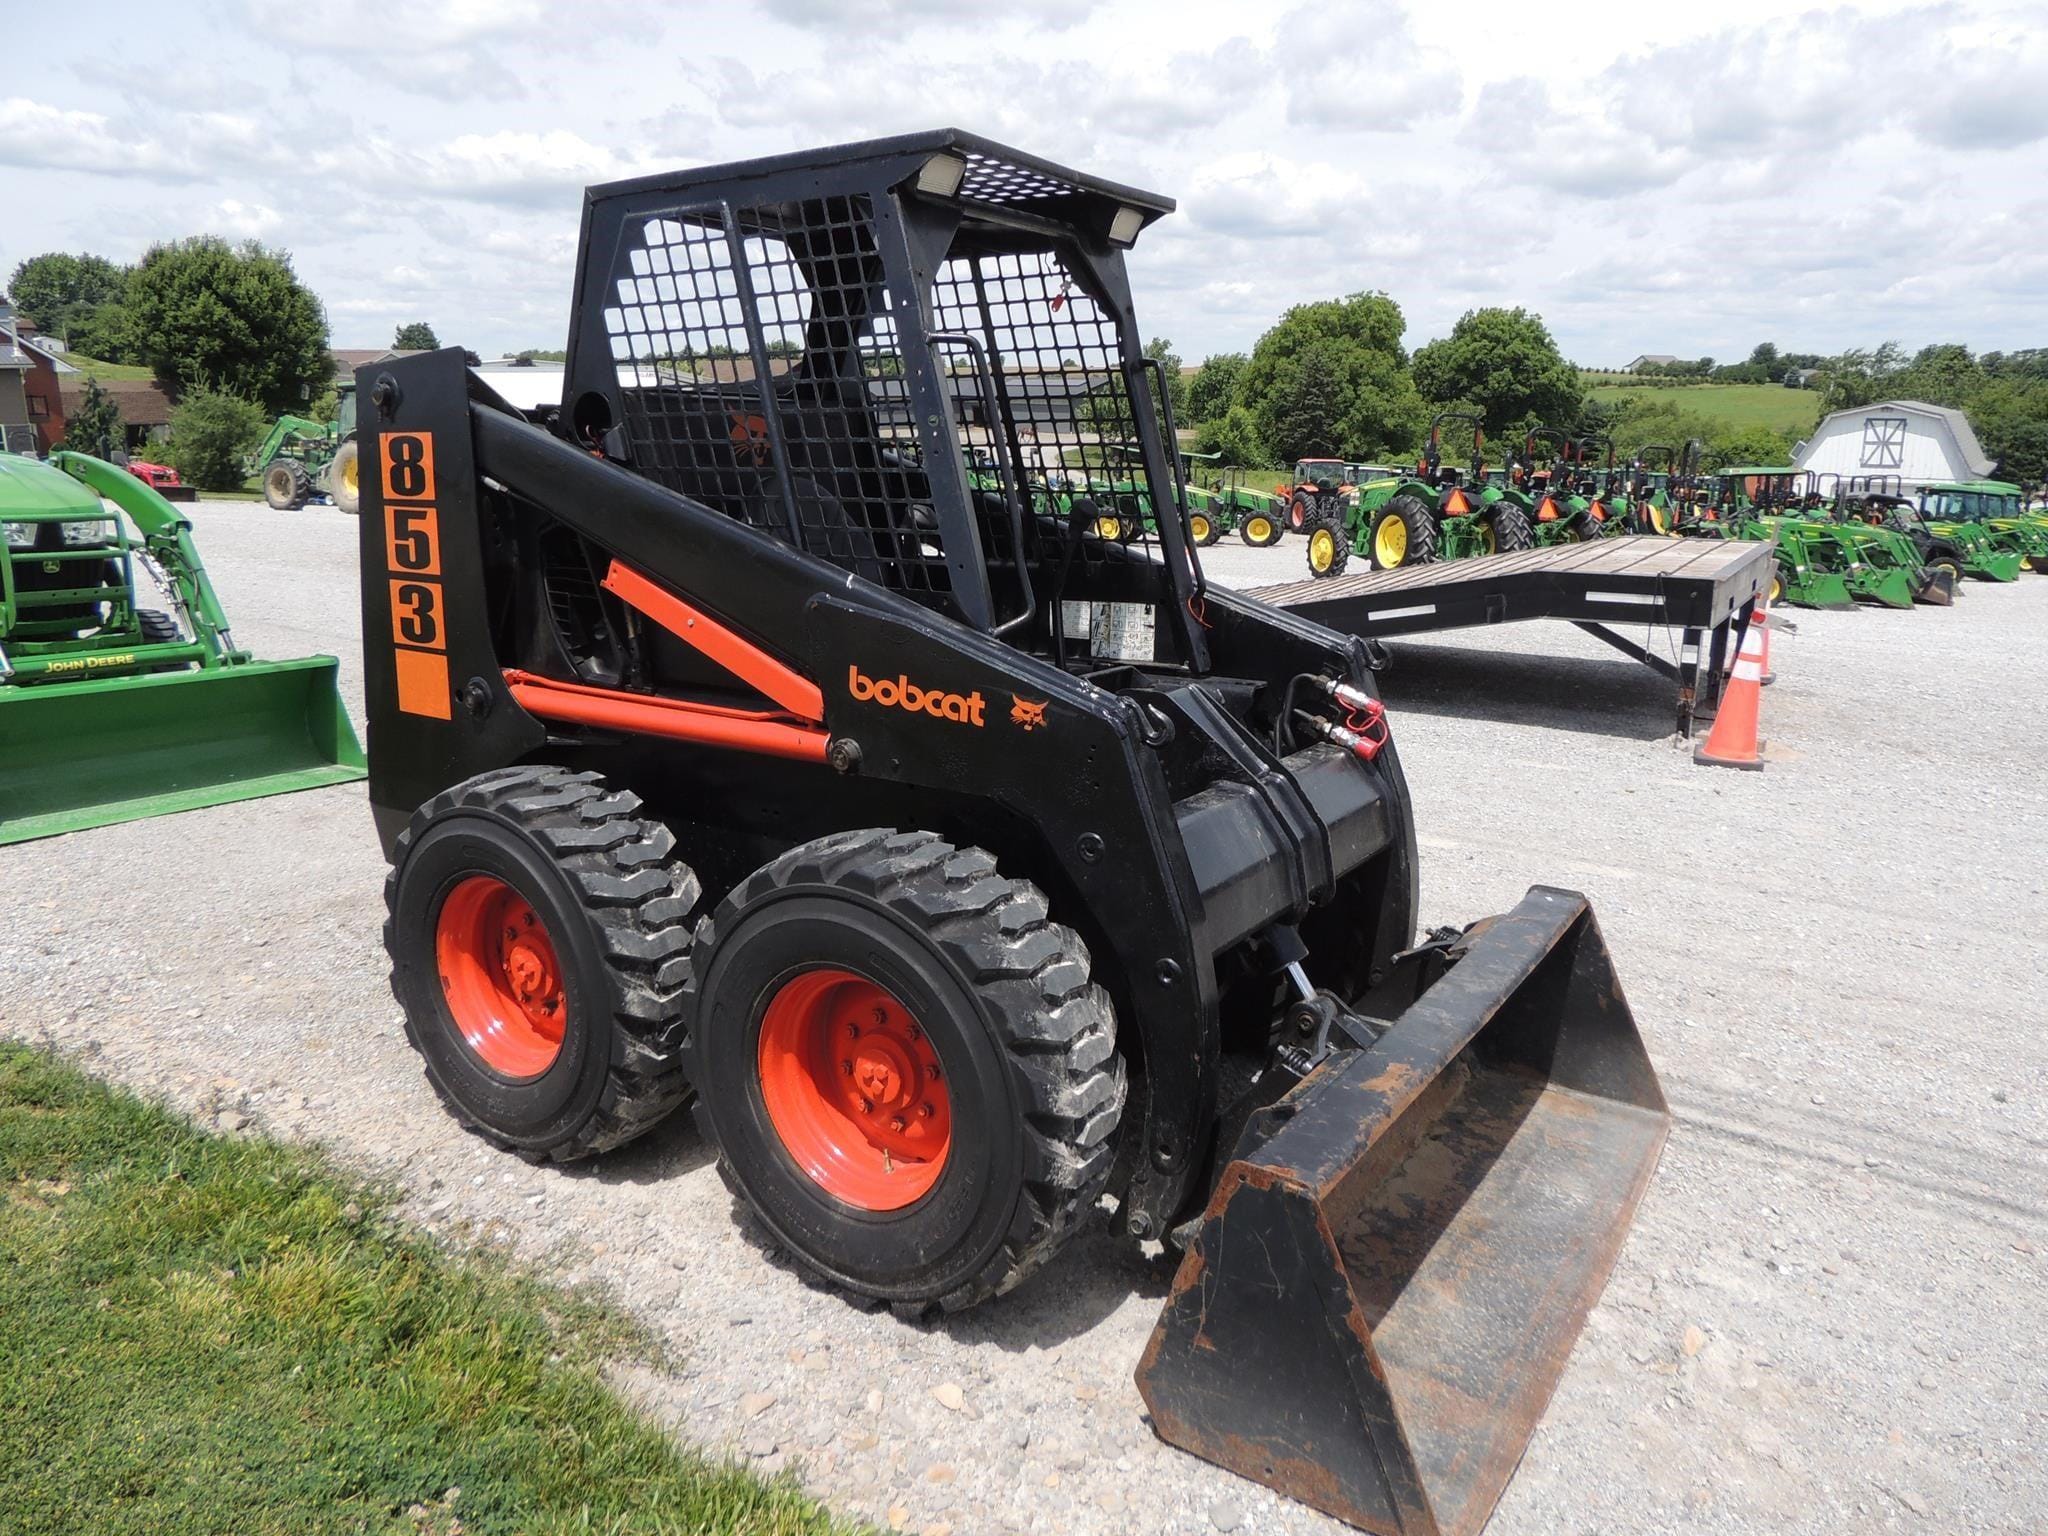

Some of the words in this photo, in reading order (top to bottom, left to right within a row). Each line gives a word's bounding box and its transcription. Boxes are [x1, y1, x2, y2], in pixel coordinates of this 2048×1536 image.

[45, 660, 85, 673] JOHN
[86, 654, 135, 668] DEERE
[849, 664, 986, 728] bobcat
